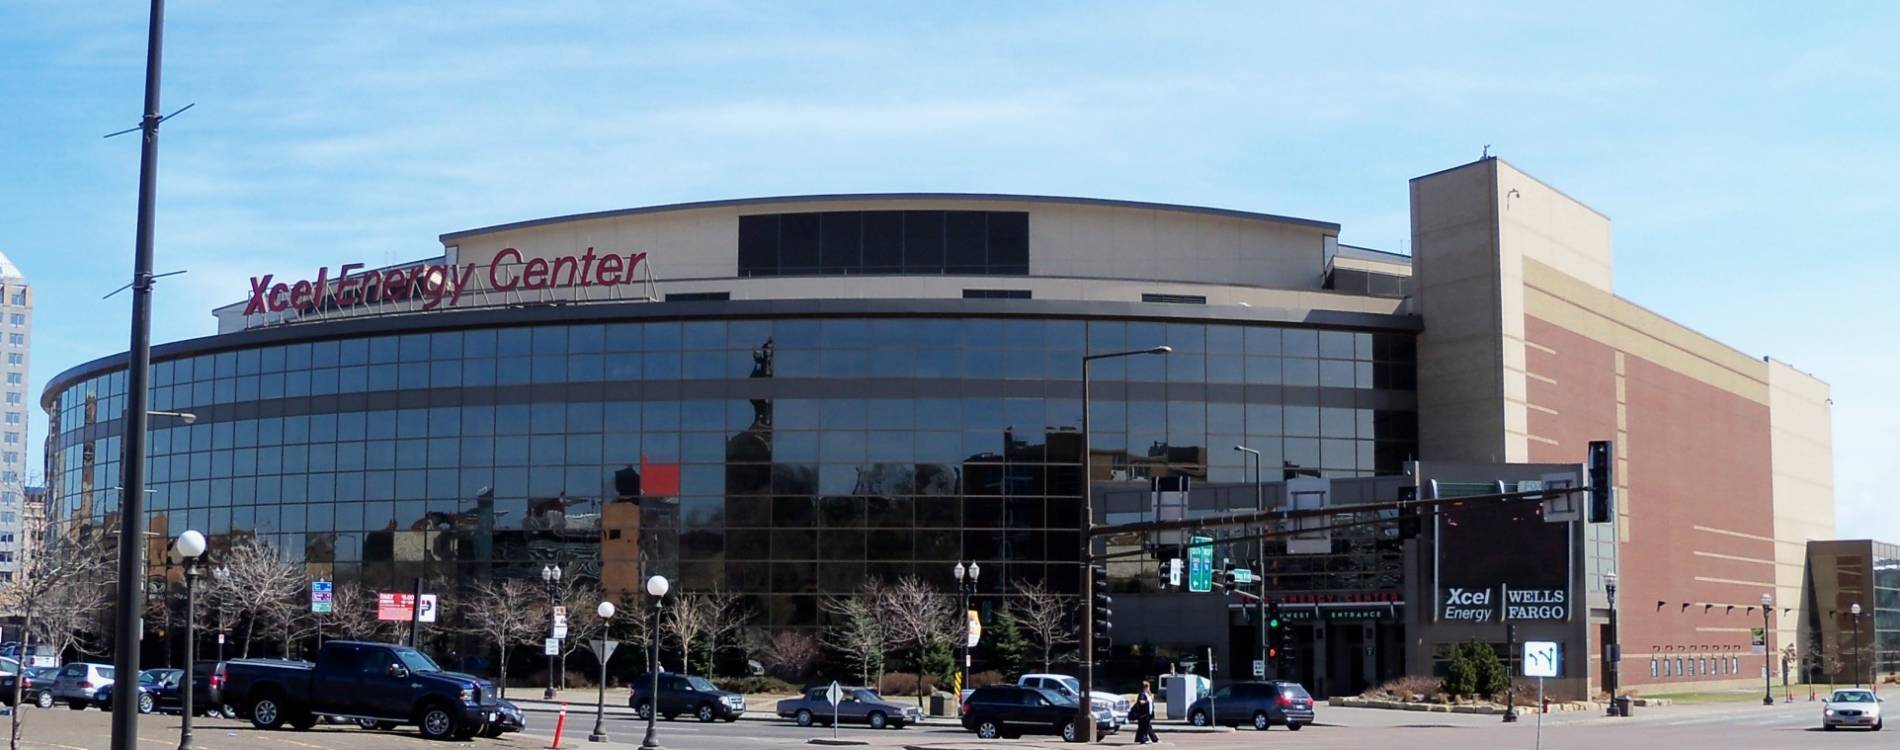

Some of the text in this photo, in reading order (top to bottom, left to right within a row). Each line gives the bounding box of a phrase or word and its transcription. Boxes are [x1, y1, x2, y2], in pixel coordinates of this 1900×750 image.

[243, 247, 647, 316] Xcel Energy Center
[1446, 588, 1491, 605] Xcel
[1507, 590, 1564, 603] WELLS
[1331, 611, 1382, 619] ENTRANCE
[1444, 606, 1492, 622] Energy
[1508, 606, 1564, 619] FARGO
